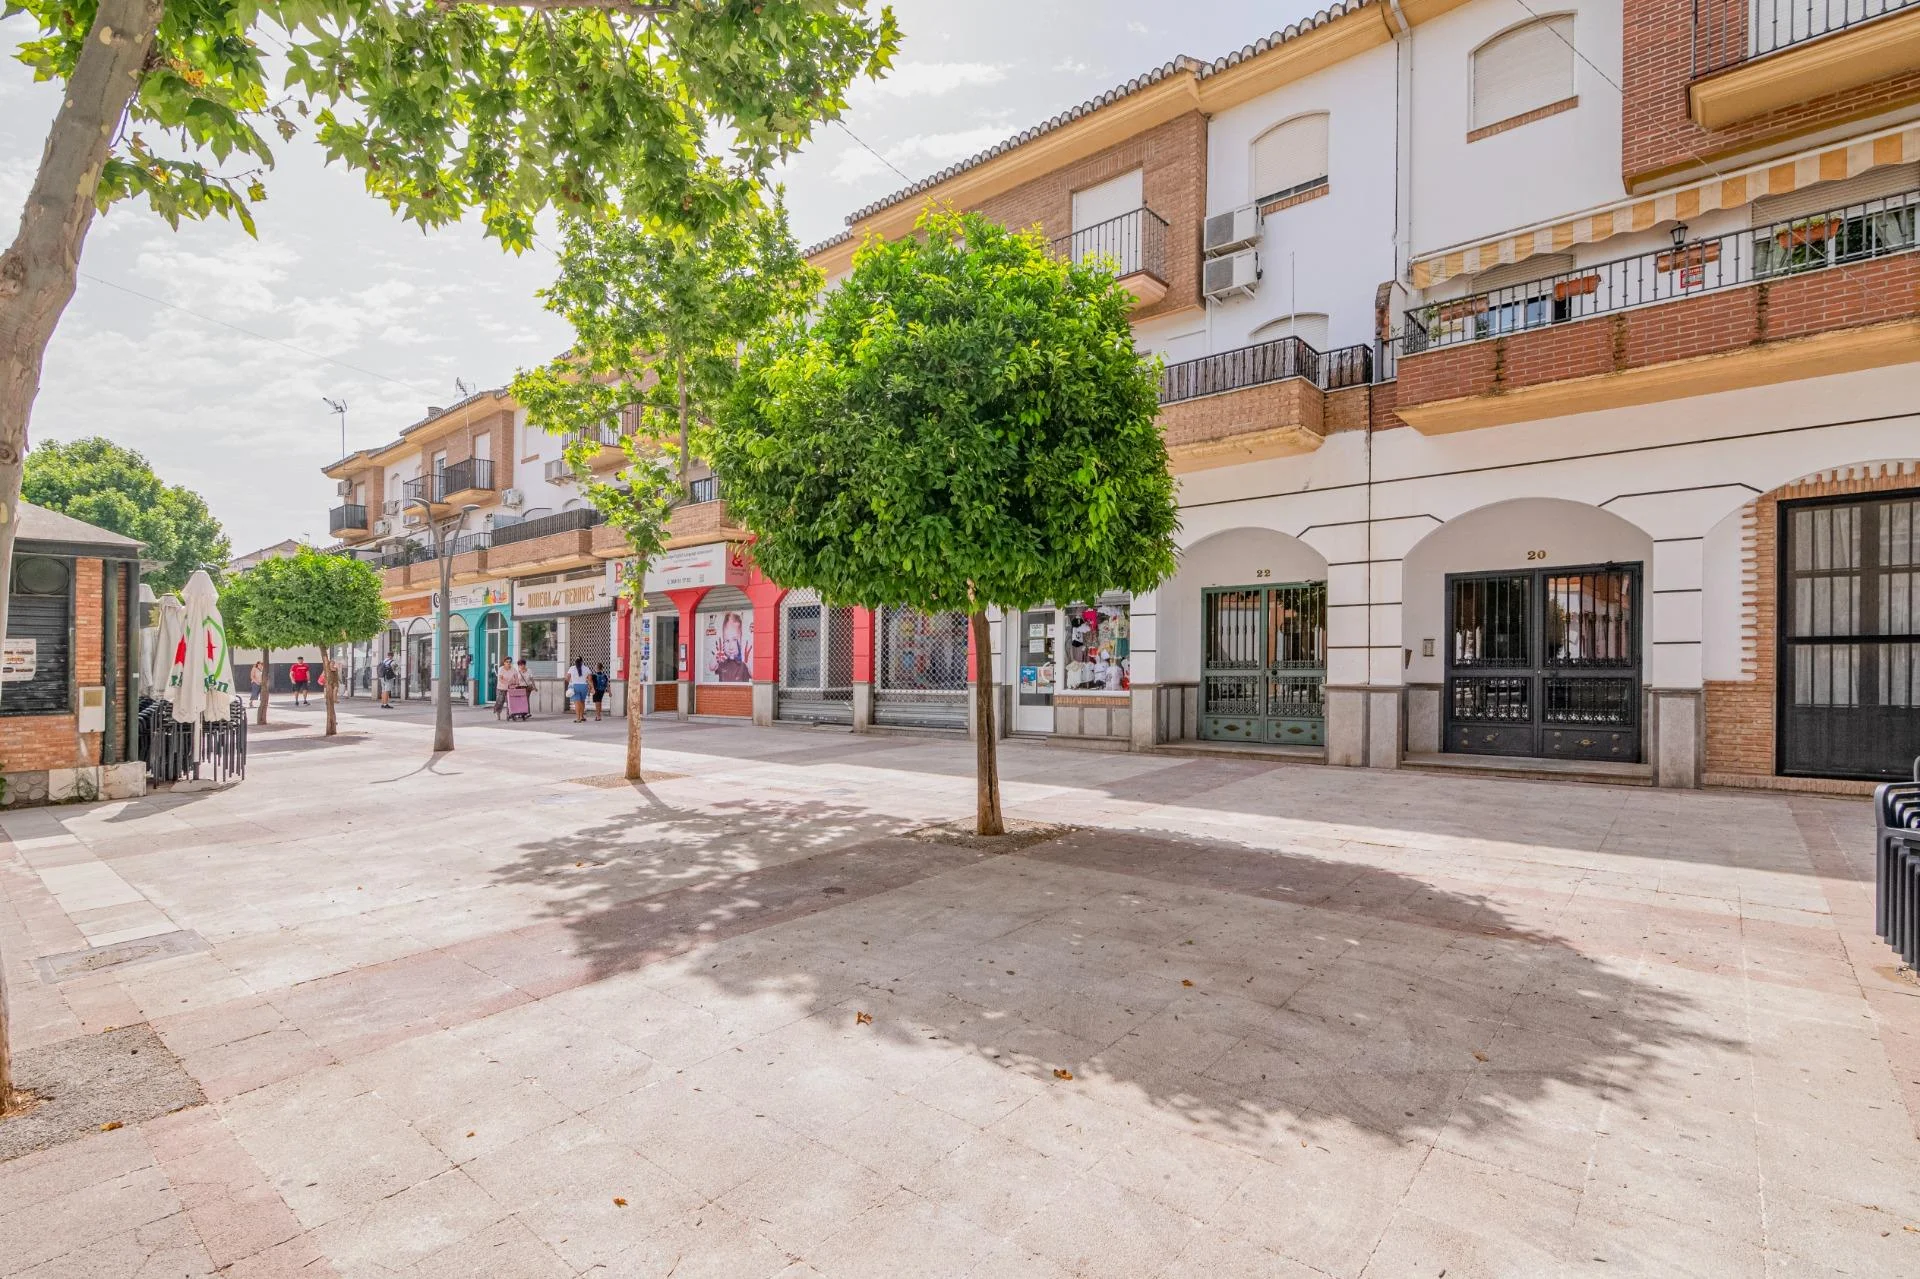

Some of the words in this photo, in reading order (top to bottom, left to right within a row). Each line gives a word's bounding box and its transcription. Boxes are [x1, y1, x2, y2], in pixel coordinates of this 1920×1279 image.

[1527, 550, 1546, 561] 20
[1256, 569, 1271, 578] 22
[527, 591, 552, 609] BODEGA
